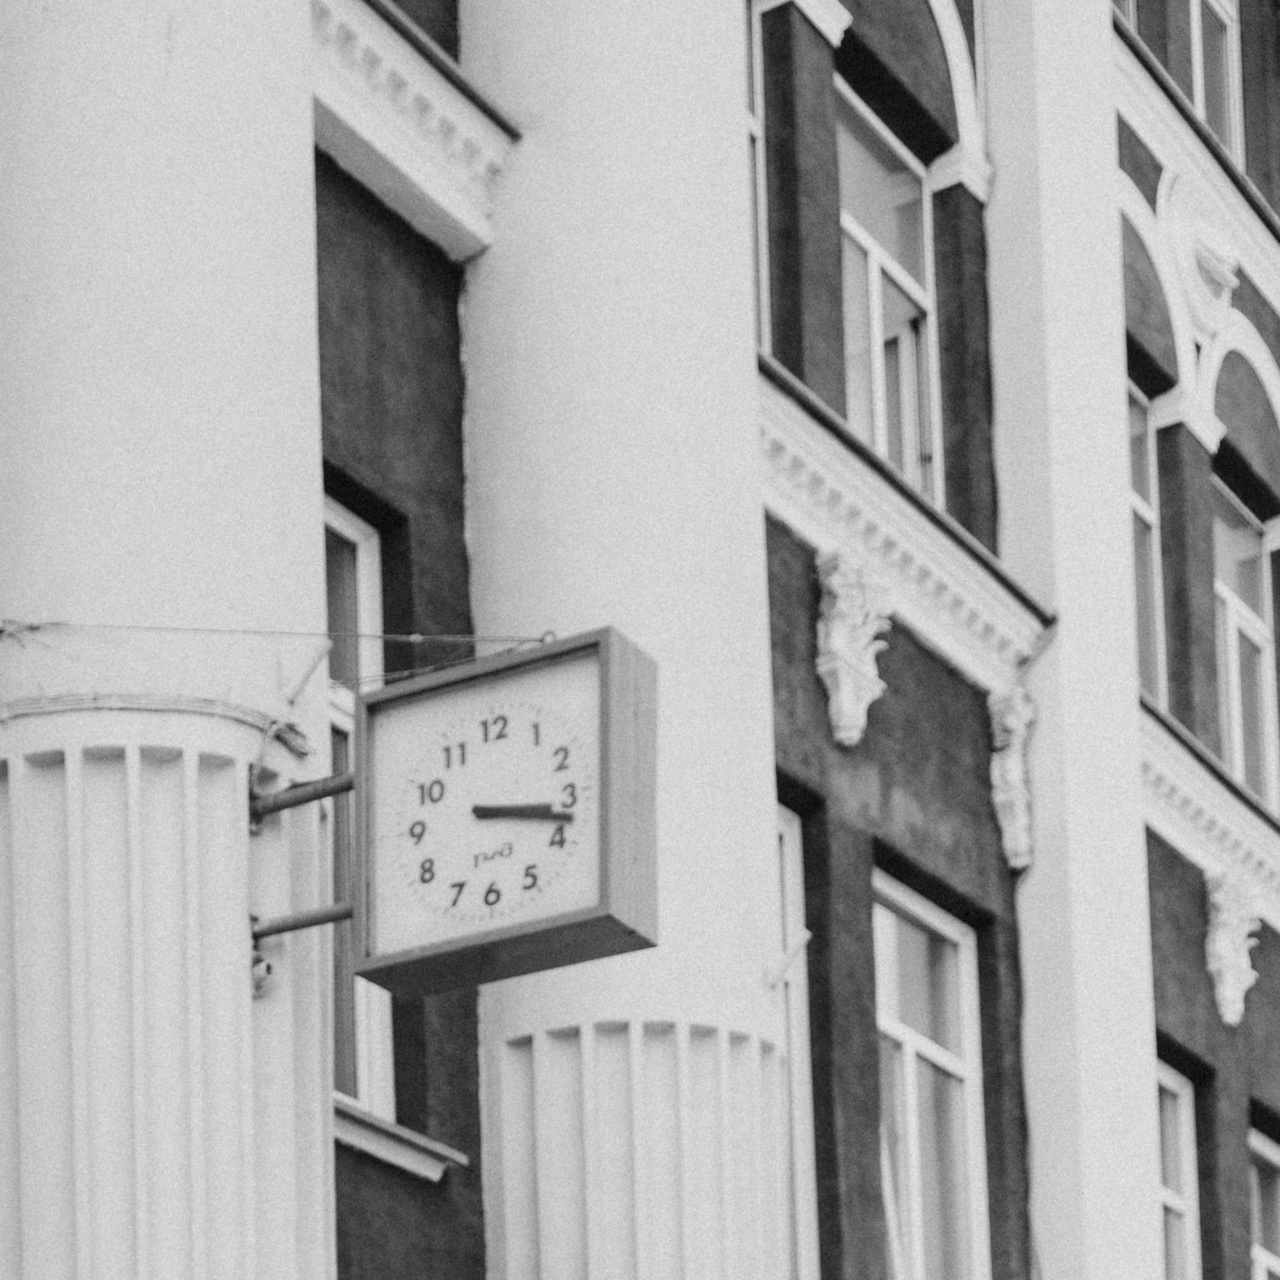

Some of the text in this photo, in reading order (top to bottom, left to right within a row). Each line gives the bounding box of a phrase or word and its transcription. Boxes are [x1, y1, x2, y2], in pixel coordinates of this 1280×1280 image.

[480, 715, 509, 743] 12
[532, 722, 541, 746] 1
[444, 742, 466, 769] 11
[553, 746, 570, 772] 2
[417, 779, 445, 806] 10
[561, 782, 577, 809] 3
[409, 820, 426, 846] 9
[548, 824, 566, 849] 4
[420, 857, 435, 884] 8
[522, 864, 538, 891] 5
[450, 881, 466, 907] 7
[483, 881, 501, 906] 6
